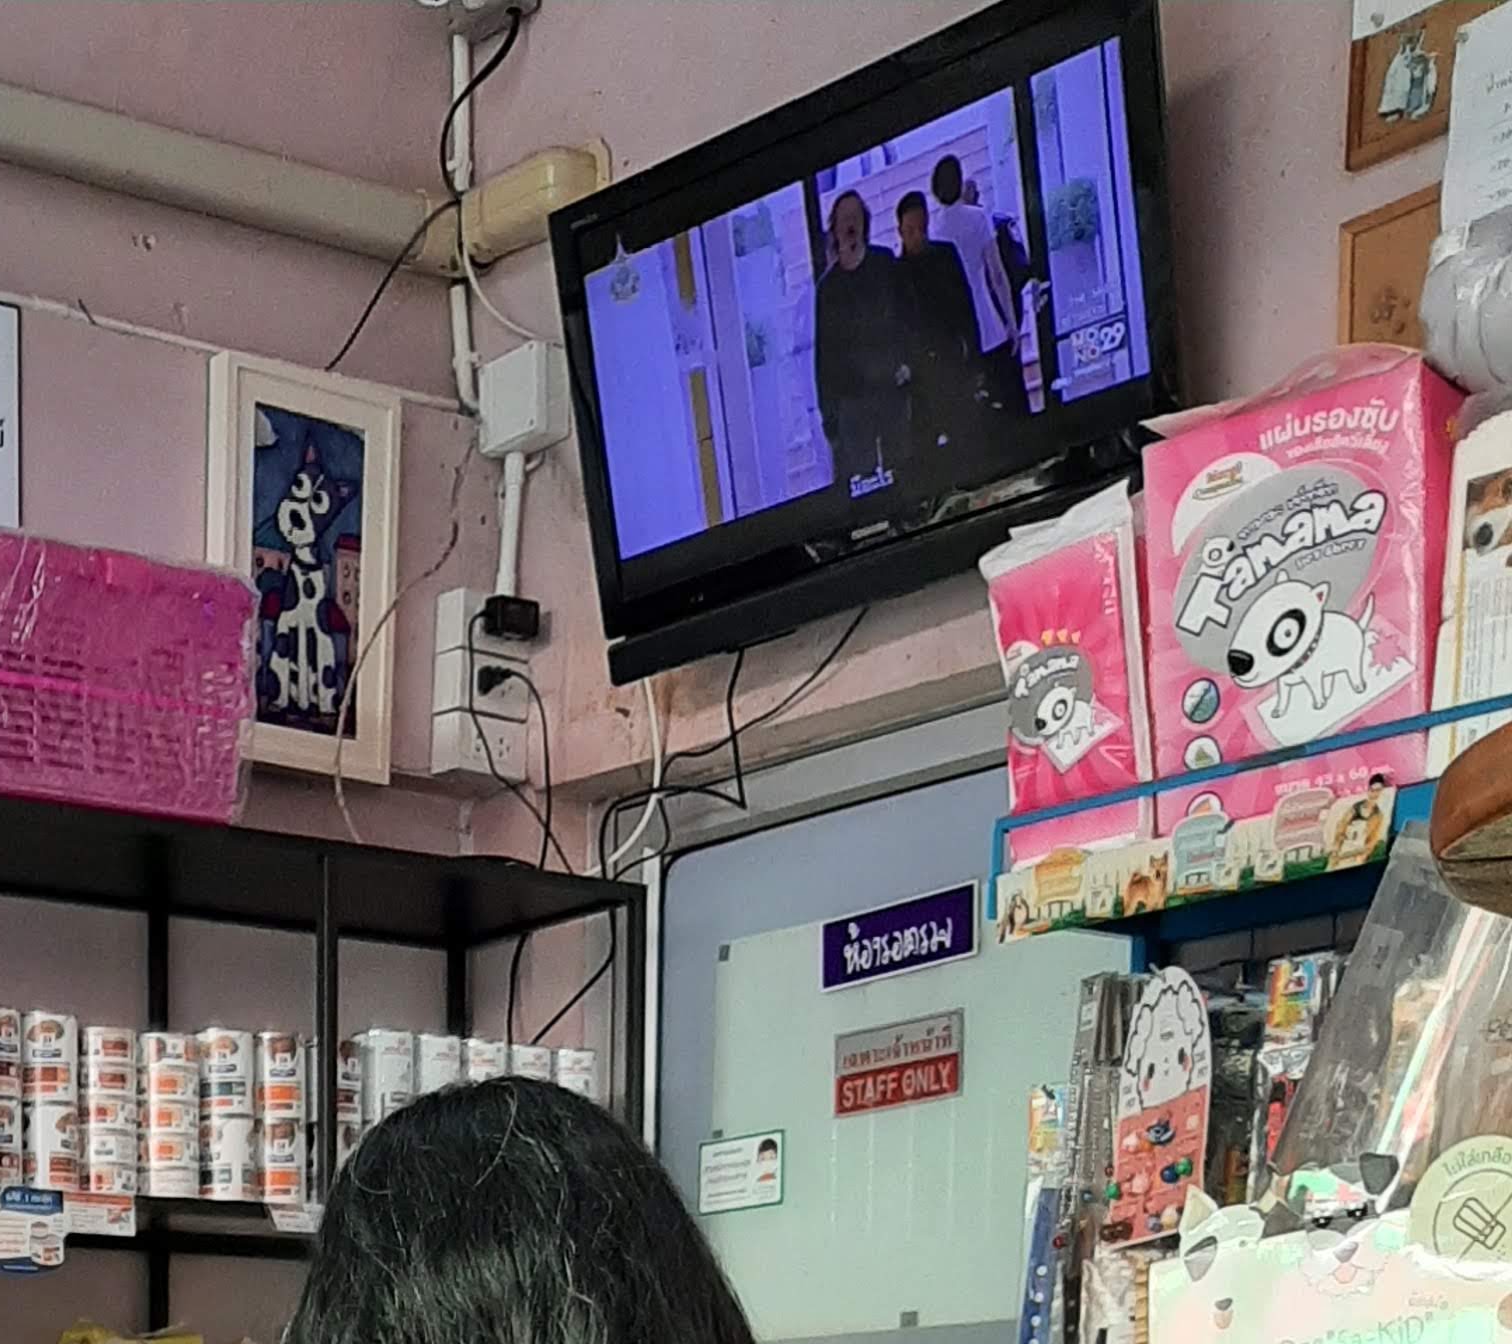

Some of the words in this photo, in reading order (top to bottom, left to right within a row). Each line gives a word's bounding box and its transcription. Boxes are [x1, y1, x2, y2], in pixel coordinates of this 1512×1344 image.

[1099, 321, 1126, 353] 29
[1258, 397, 1400, 452] แผ่นรองซับ
[842, 1020, 954, 1069] เฉพาะเจ้าหน้าที่
[841, 1071, 900, 1108] STAFF
[901, 1061, 953, 1096] ONLY
